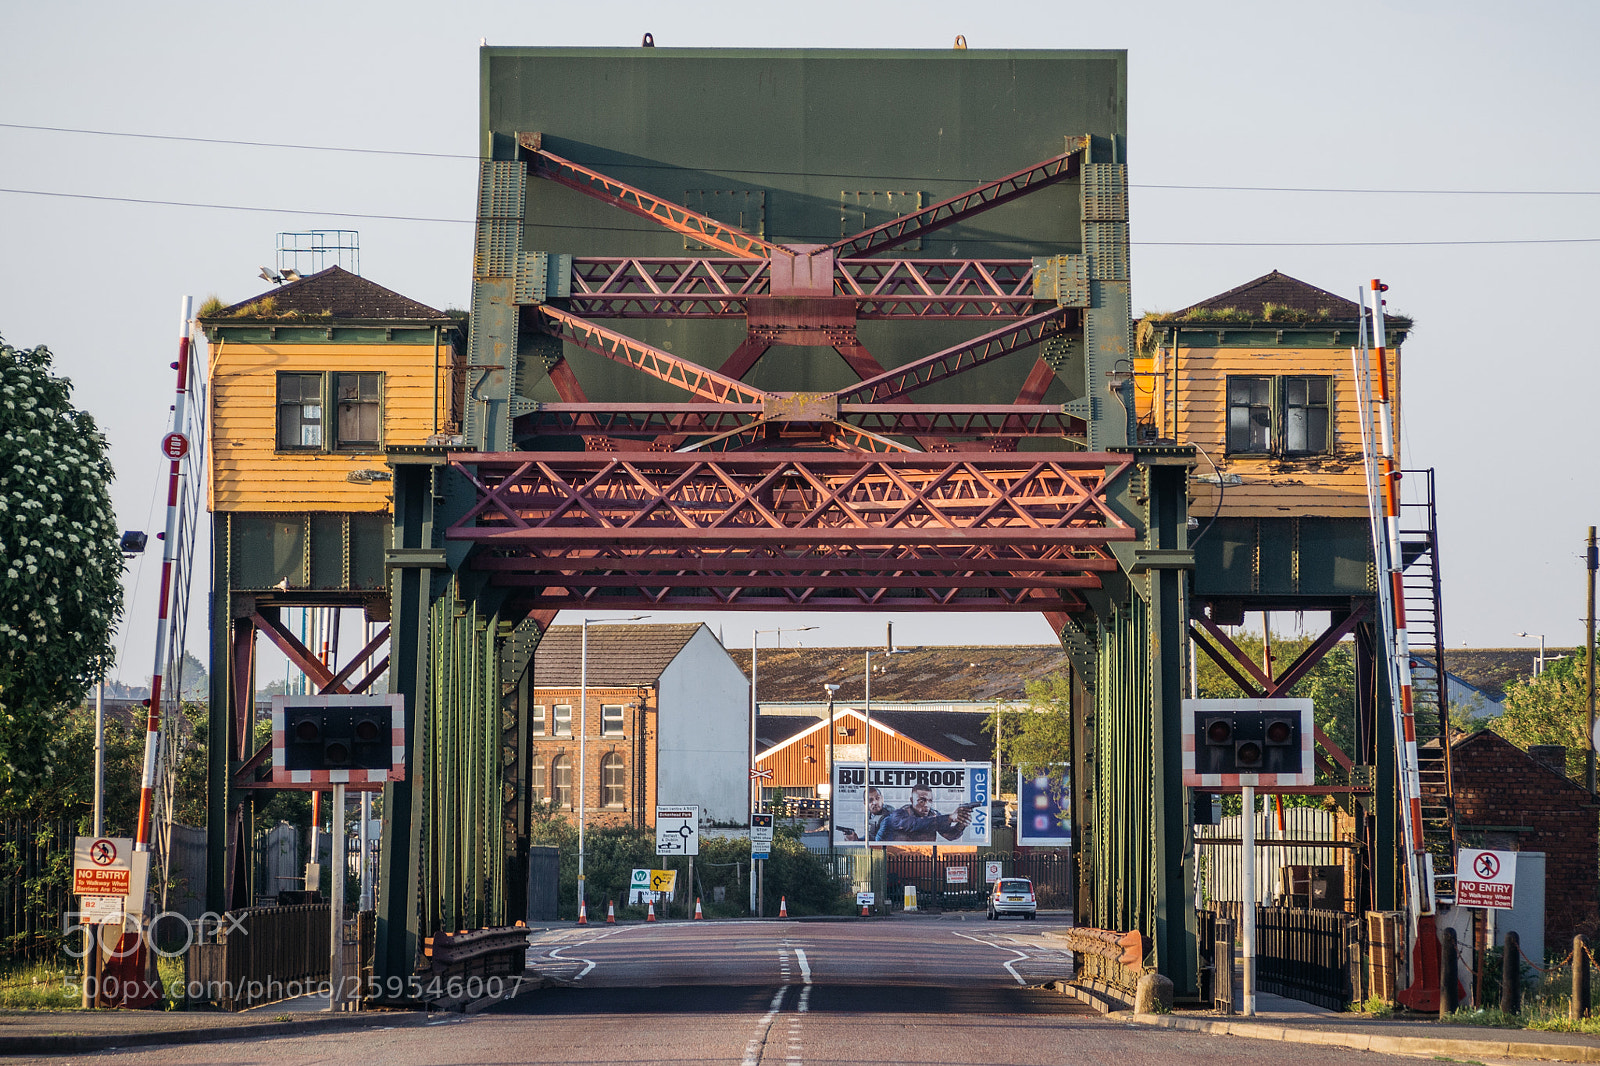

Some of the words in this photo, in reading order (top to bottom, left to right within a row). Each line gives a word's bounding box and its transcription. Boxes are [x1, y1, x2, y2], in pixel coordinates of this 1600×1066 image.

[170, 436, 181, 456] STOP
[839, 769, 965, 786] BULLETPROOF
[975, 773, 986, 803] one
[972, 809, 987, 835] sky
[78, 870, 93, 879] NO
[96, 871, 127, 879] ENTRY
[1461, 882, 1476, 891] NO
[1479, 883, 1510, 893] ENTRY
